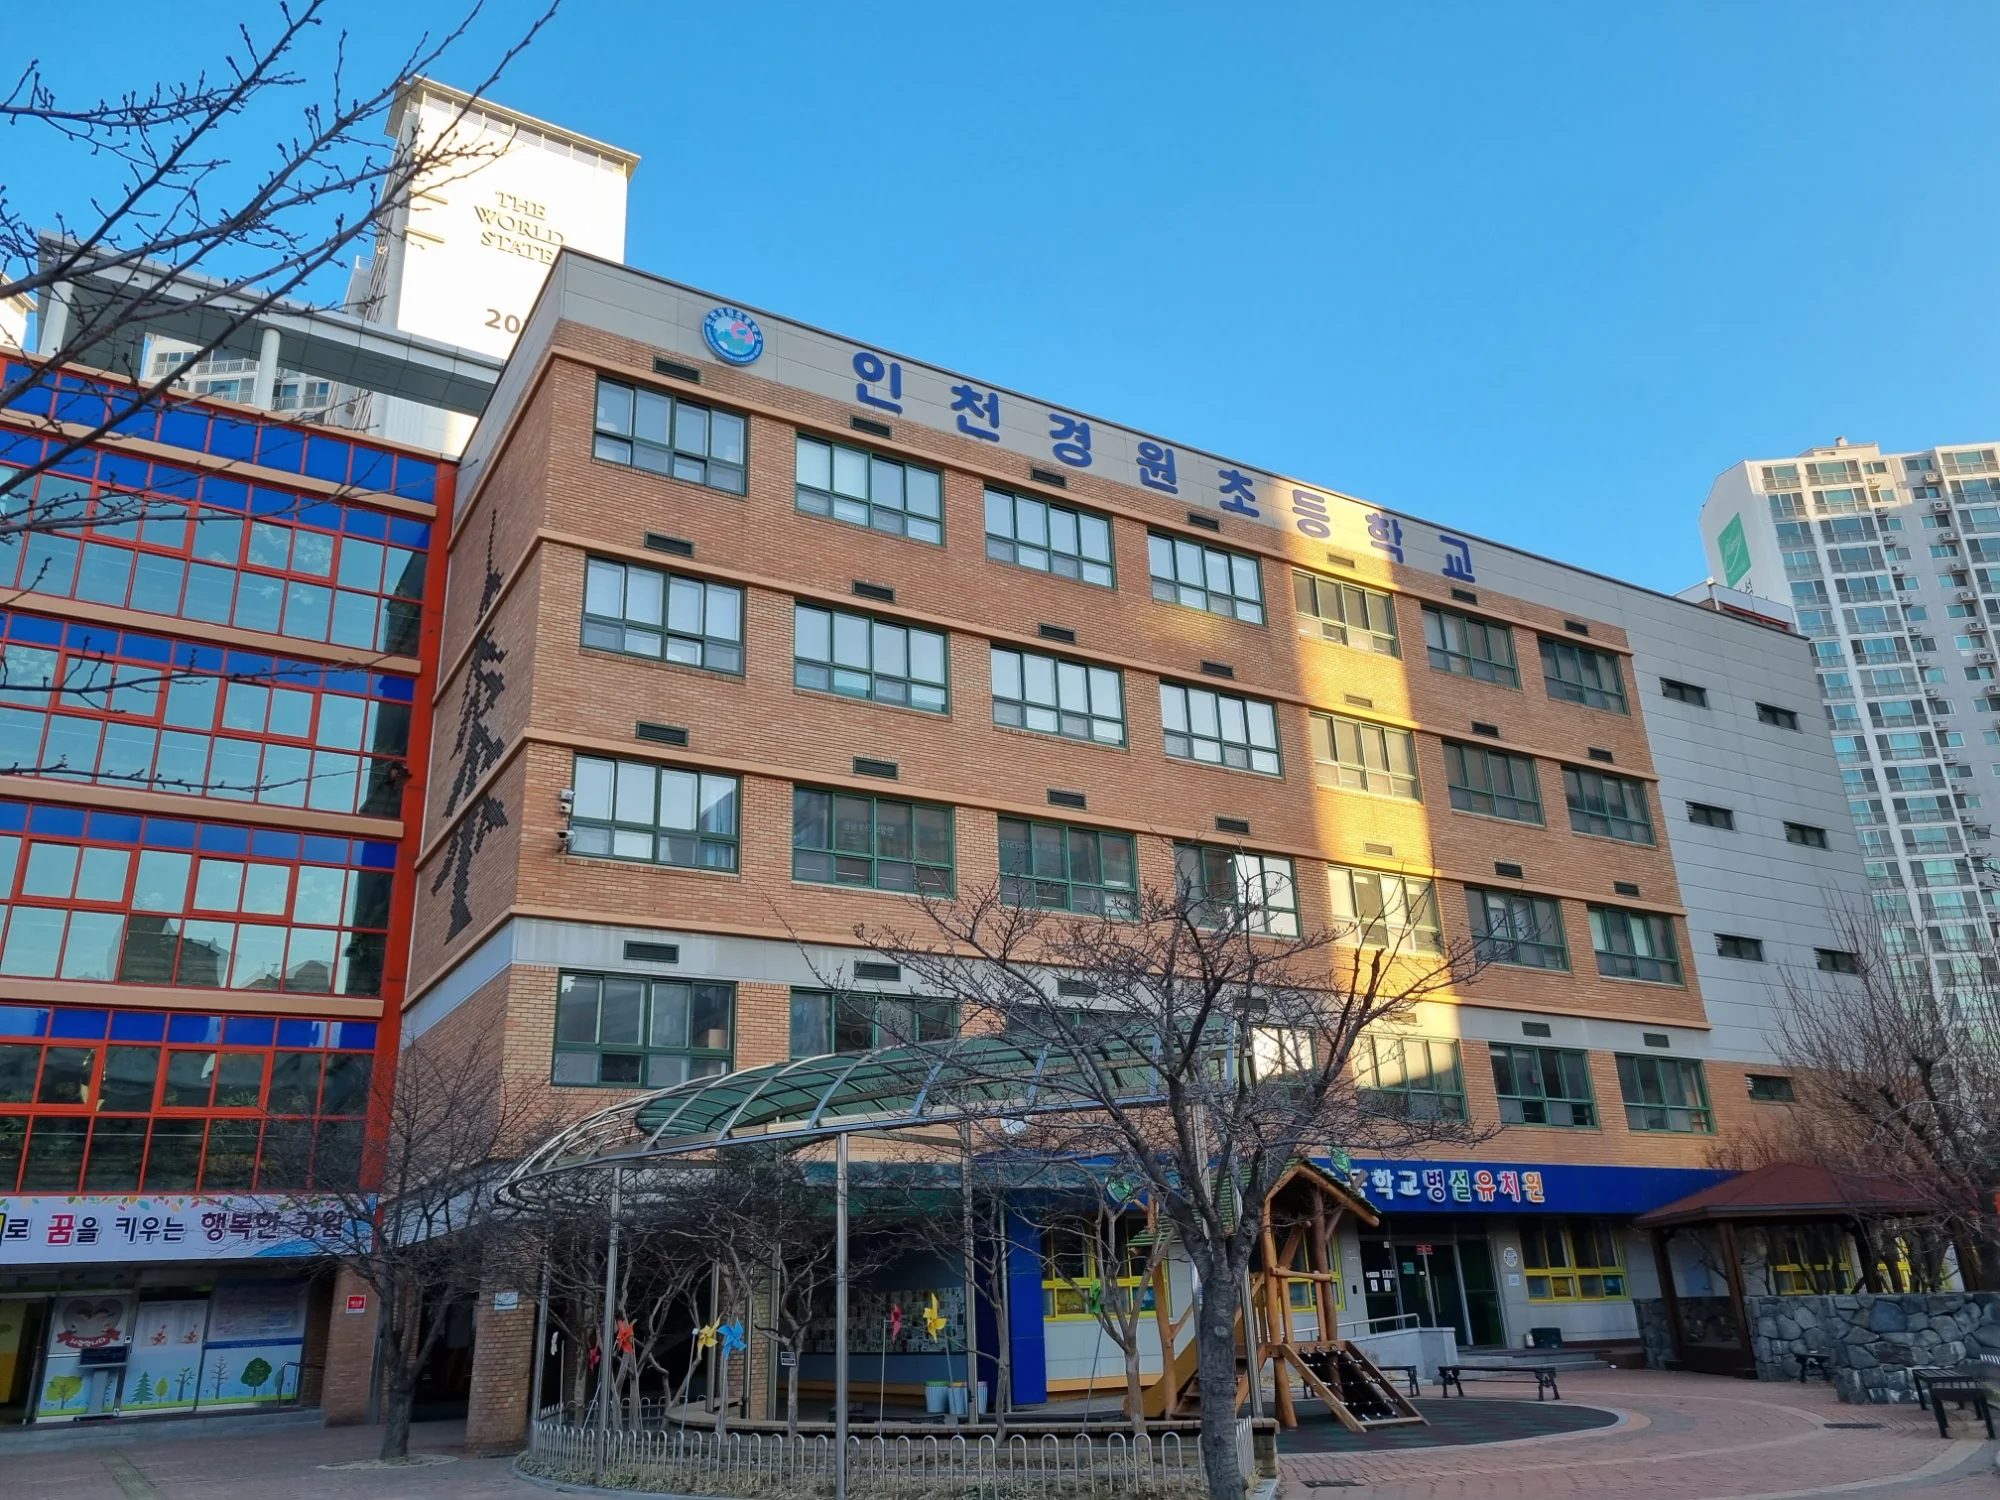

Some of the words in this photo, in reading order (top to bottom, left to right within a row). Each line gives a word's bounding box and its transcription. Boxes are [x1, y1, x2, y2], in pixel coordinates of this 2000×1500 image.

[494, 191, 546, 221] THE
[474, 205, 564, 247] WORLD
[480, 231, 554, 266] STATE
[484, 308, 527, 334] 20
[1322, 1167, 1545, 1204] 학교병설유치원
[47, 1214, 99, 1244] 꿈을
[115, 1216, 185, 1242] 키우는
[201, 1212, 281, 1241] 행복한
